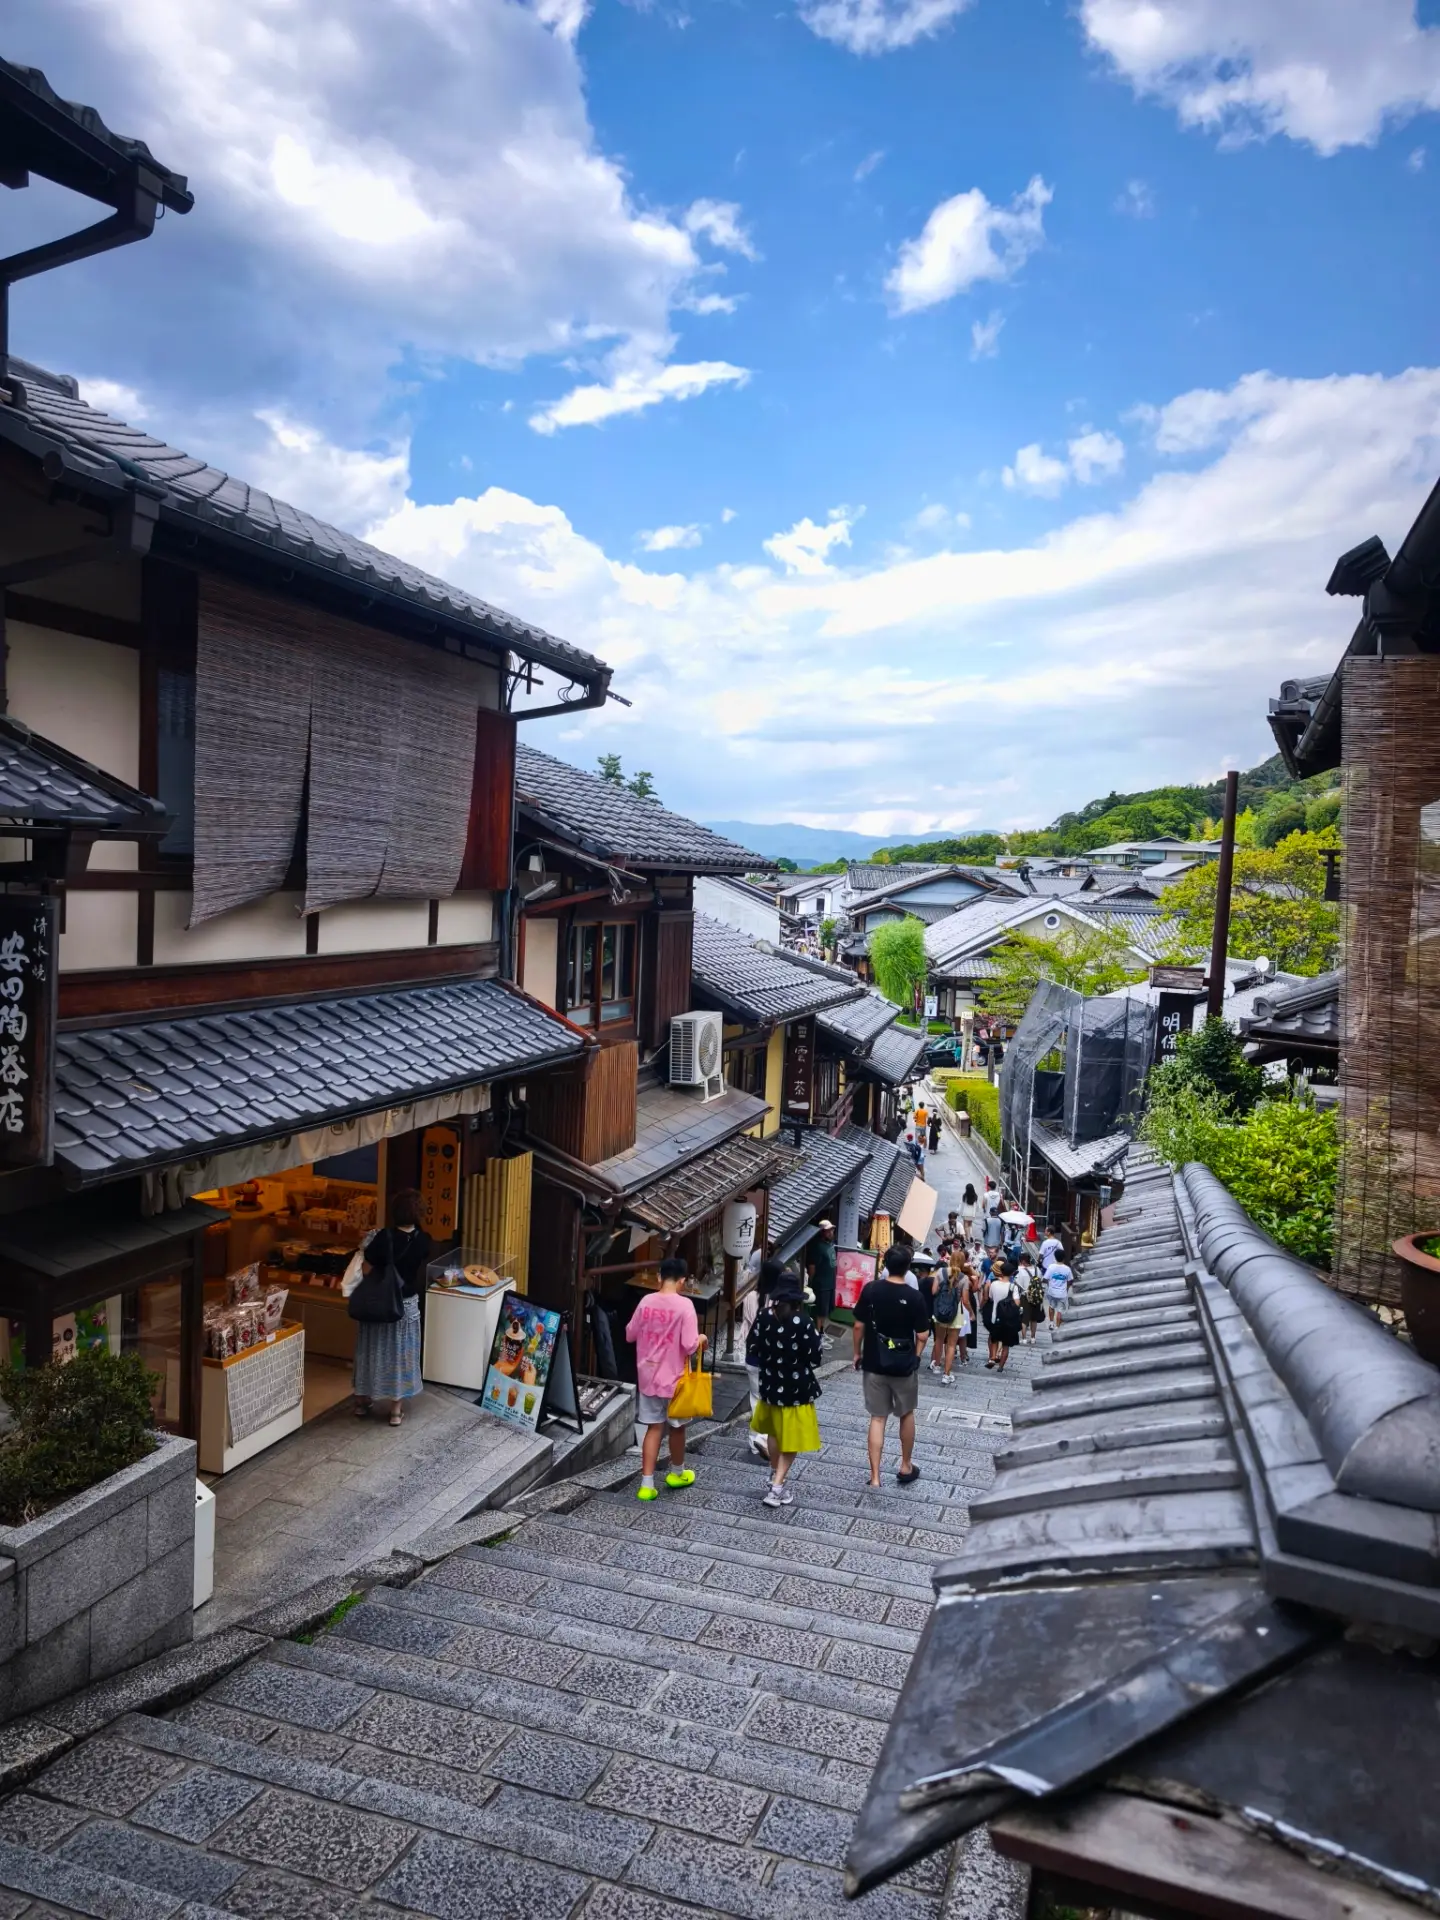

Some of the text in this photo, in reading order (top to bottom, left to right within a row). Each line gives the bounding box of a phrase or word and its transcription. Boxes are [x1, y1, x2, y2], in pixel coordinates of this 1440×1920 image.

[32, 917, 49, 982] 清水焼
[0, 931, 30, 1133] 安田陶器店
[736, 1216, 754, 1238] 香
